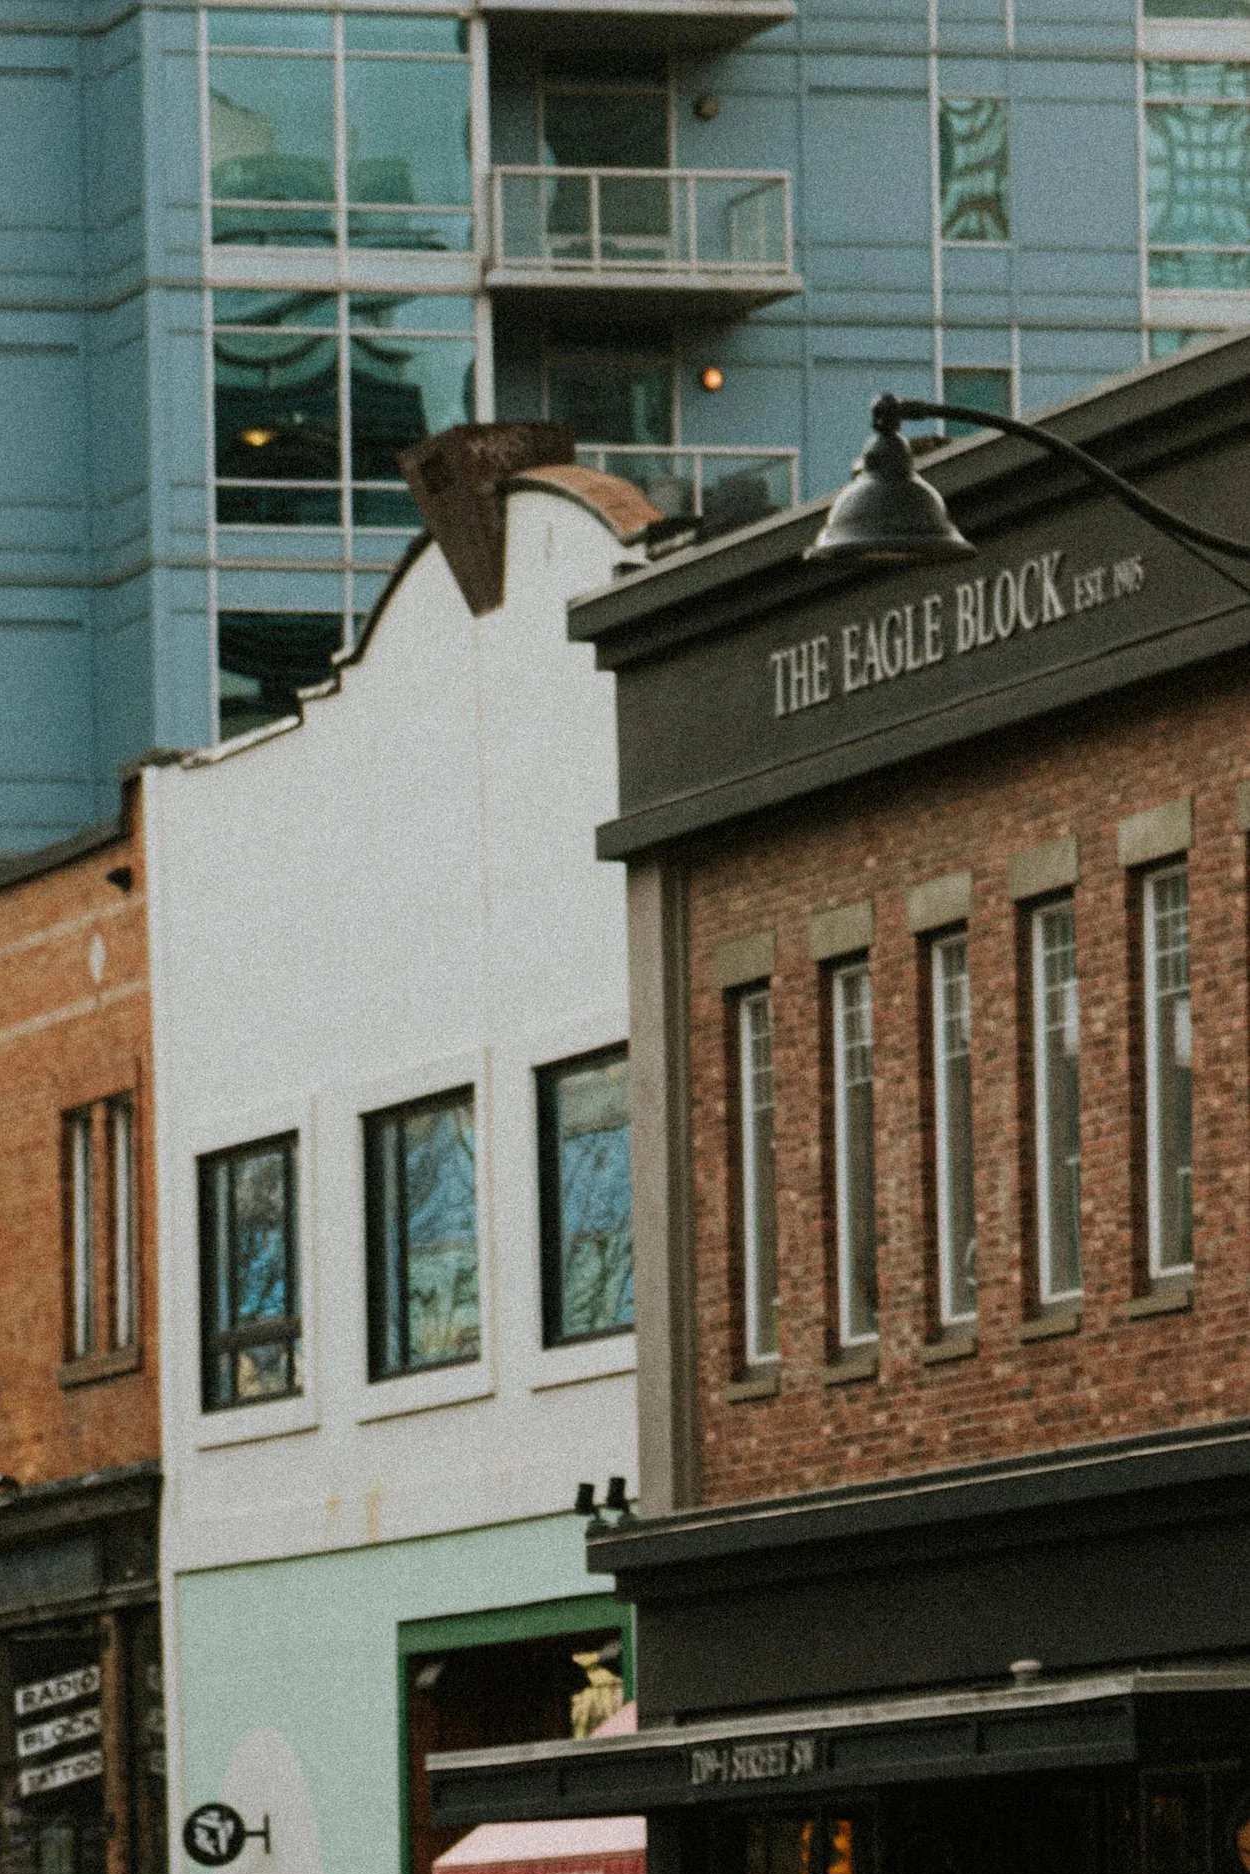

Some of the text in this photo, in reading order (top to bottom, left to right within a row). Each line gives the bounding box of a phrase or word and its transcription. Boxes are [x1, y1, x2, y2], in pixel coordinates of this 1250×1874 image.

[770, 636, 830, 718] THE
[842, 594, 944, 693] EAGLE
[955, 550, 1066, 655] BLOCK
[22, 1668, 98, 1707] RADIO
